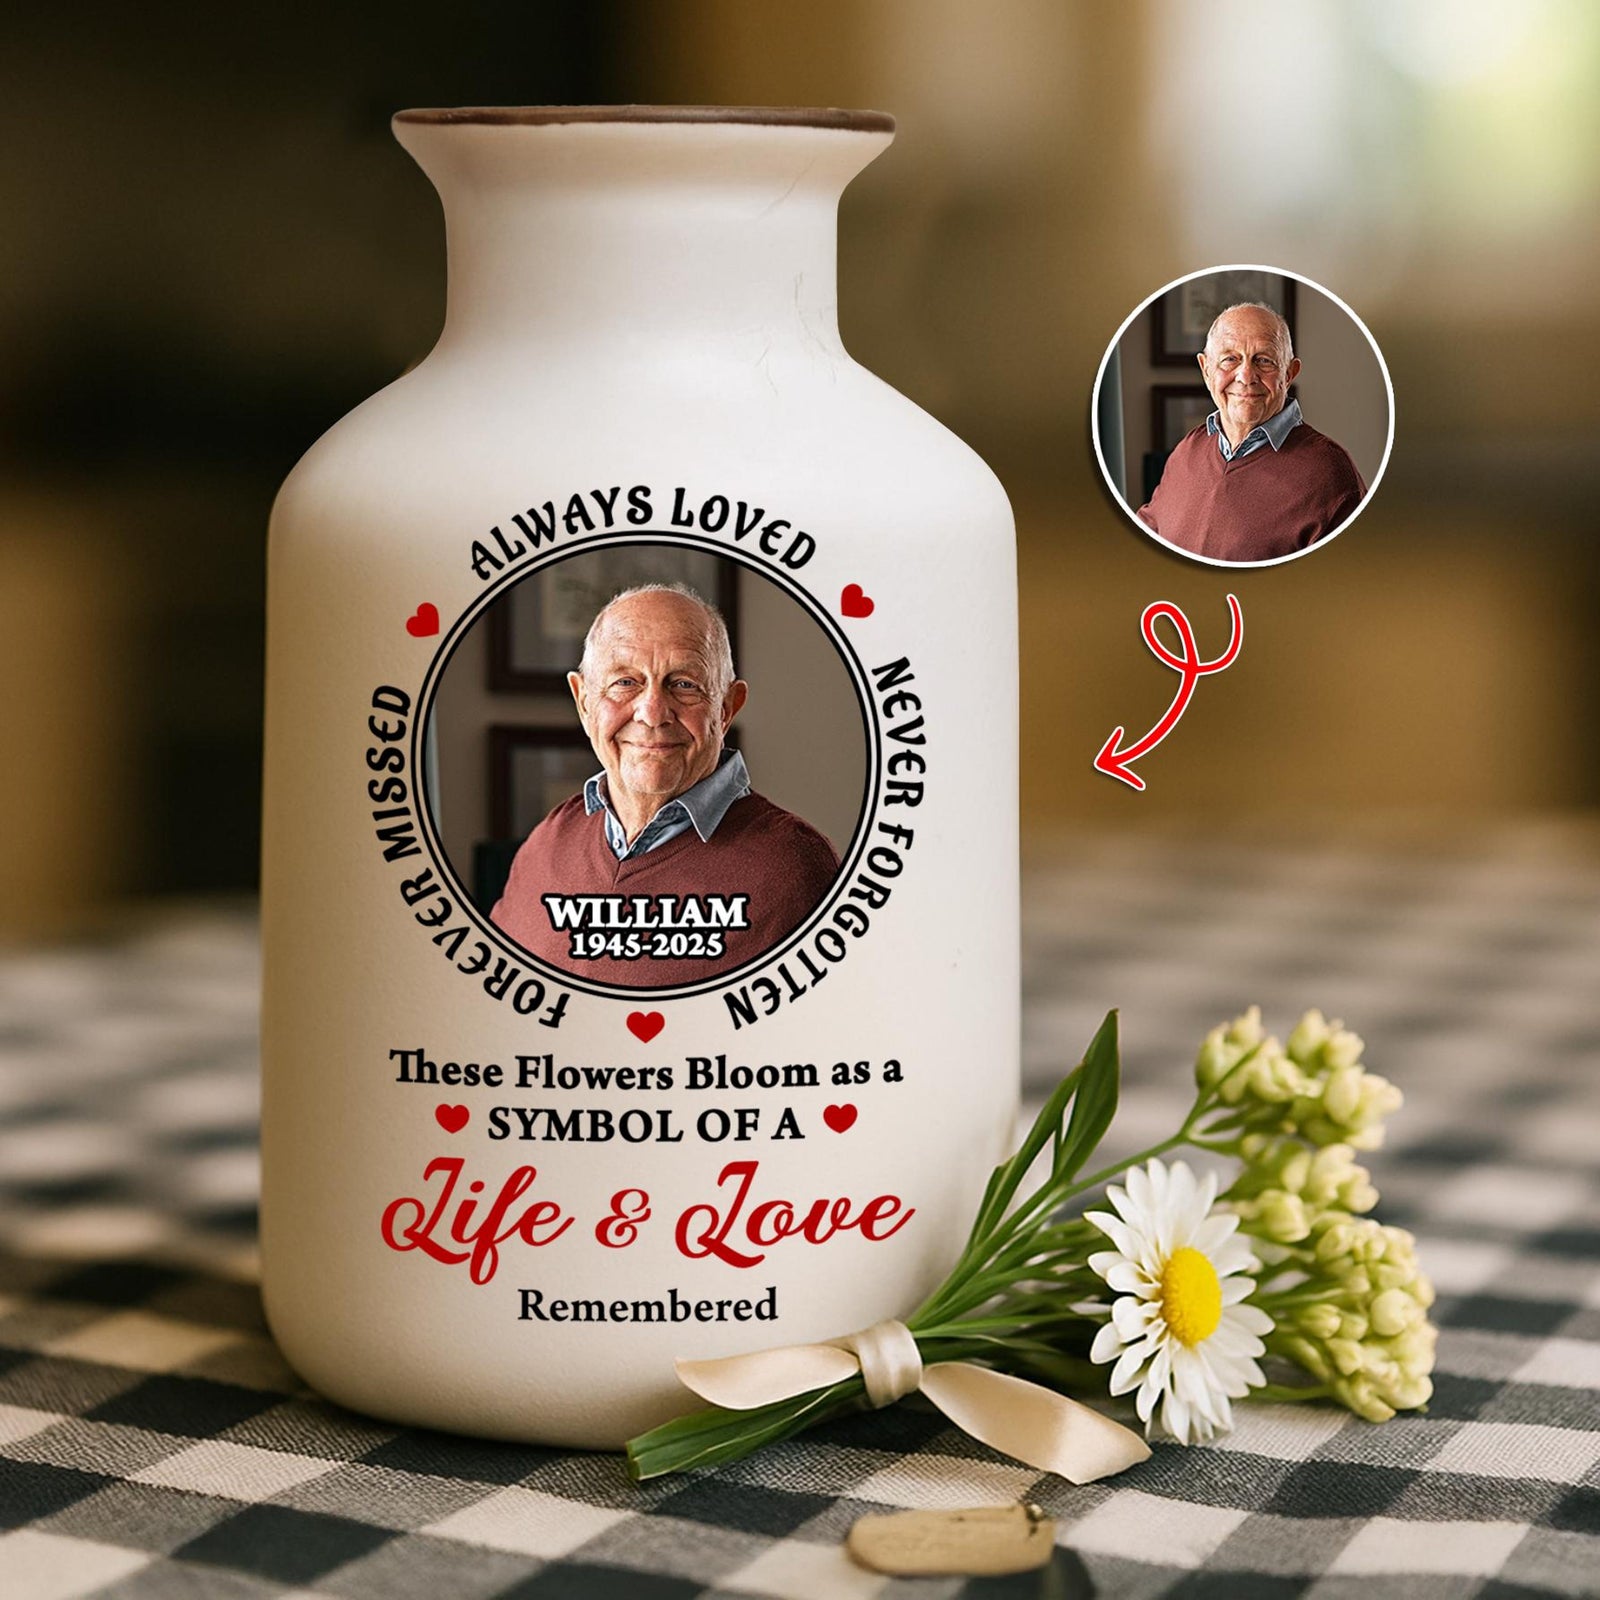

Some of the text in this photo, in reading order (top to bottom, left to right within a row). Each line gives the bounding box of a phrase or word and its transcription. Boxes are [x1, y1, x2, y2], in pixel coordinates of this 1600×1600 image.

[470, 485, 816, 580] ALWAYS LOVED
[366, 684, 571, 1028] FOREVER MISSED
[723, 656, 927, 1030] NEVER FORGOTTEN
[544, 897, 748, 928] WILLIAM
[572, 932, 724, 957] 1945-2025
[389, 1048, 904, 1090] These Flowers Bloom as a
[487, 1107, 805, 1142] SYMBOL OF A
[381, 1157, 916, 1285] Life & Love
[517, 1287, 778, 1322] Remembered
